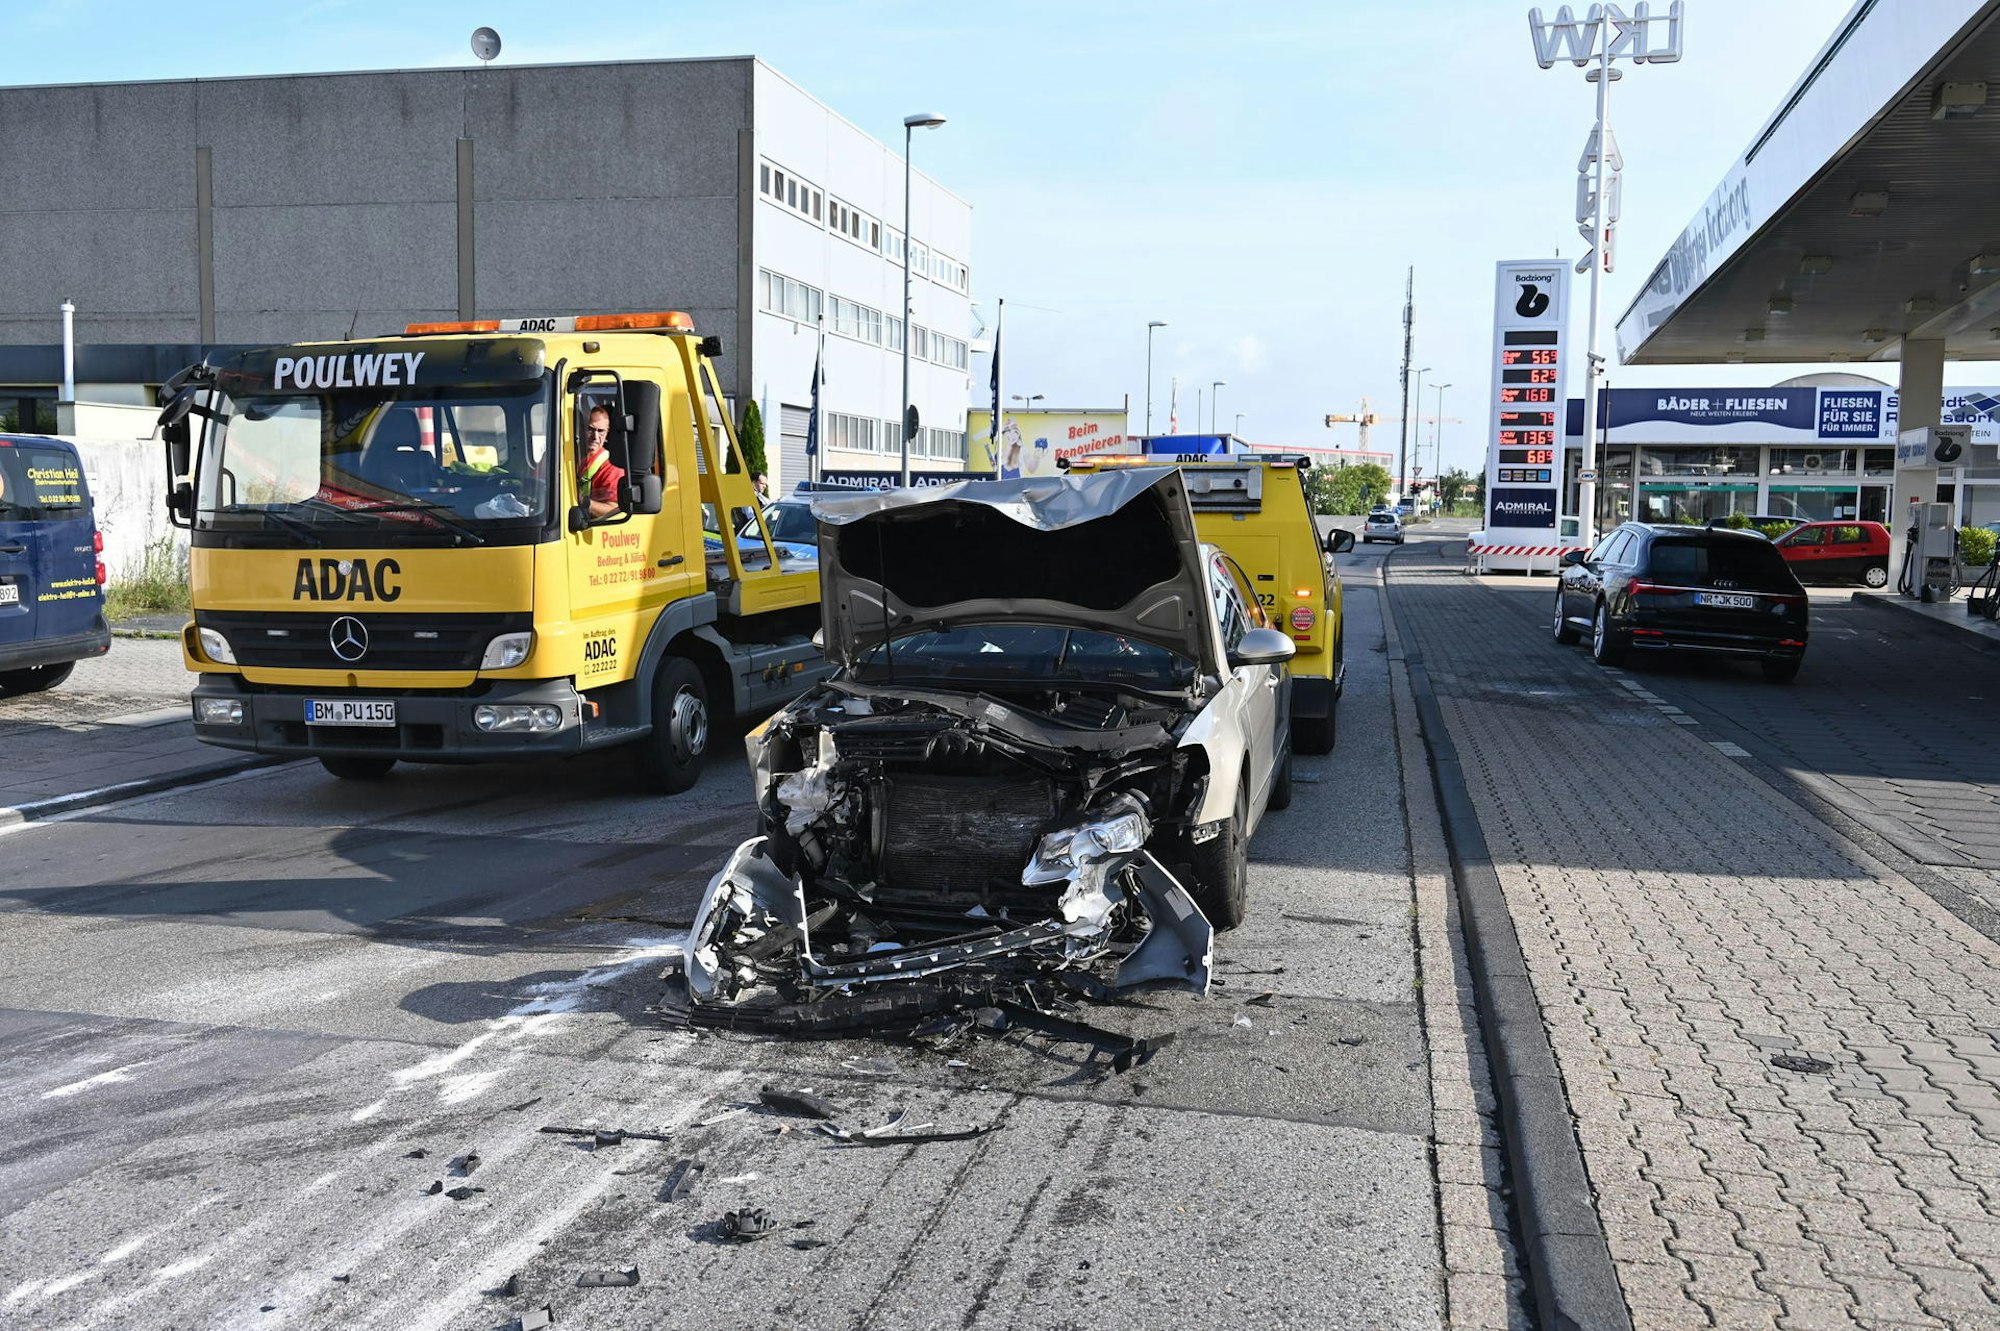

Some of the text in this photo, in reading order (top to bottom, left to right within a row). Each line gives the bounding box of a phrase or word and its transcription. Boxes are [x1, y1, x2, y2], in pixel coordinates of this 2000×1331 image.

[1516, 275, 1551, 283] Badziong
[519, 319, 556, 332] ADAC
[274, 352, 425, 389] POULWEY
[1525, 388, 1548, 401] 168
[1657, 396, 1709, 410] BÄDER
[1725, 399, 1788, 410] FLIESEN
[1823, 398, 1877, 408] FLIESEN.
[1823, 409, 1876, 422] FÜR SIE.
[1068, 422, 1098, 439] Beim
[1822, 423, 1839, 432] FÜR
[1054, 434, 1122, 460] Renovieren
[1176, 454, 1208, 463] ADAC
[27, 467, 64, 479] Christian
[1495, 501, 1552, 511] ADMIRAL
[602, 530, 640, 549] Poulwey
[293, 558, 402, 602] ADAC
[1700, 594, 1752, 607] NR JK 500
[584, 637, 617, 661] ADAC
[315, 702, 394, 720] BM PU 150
